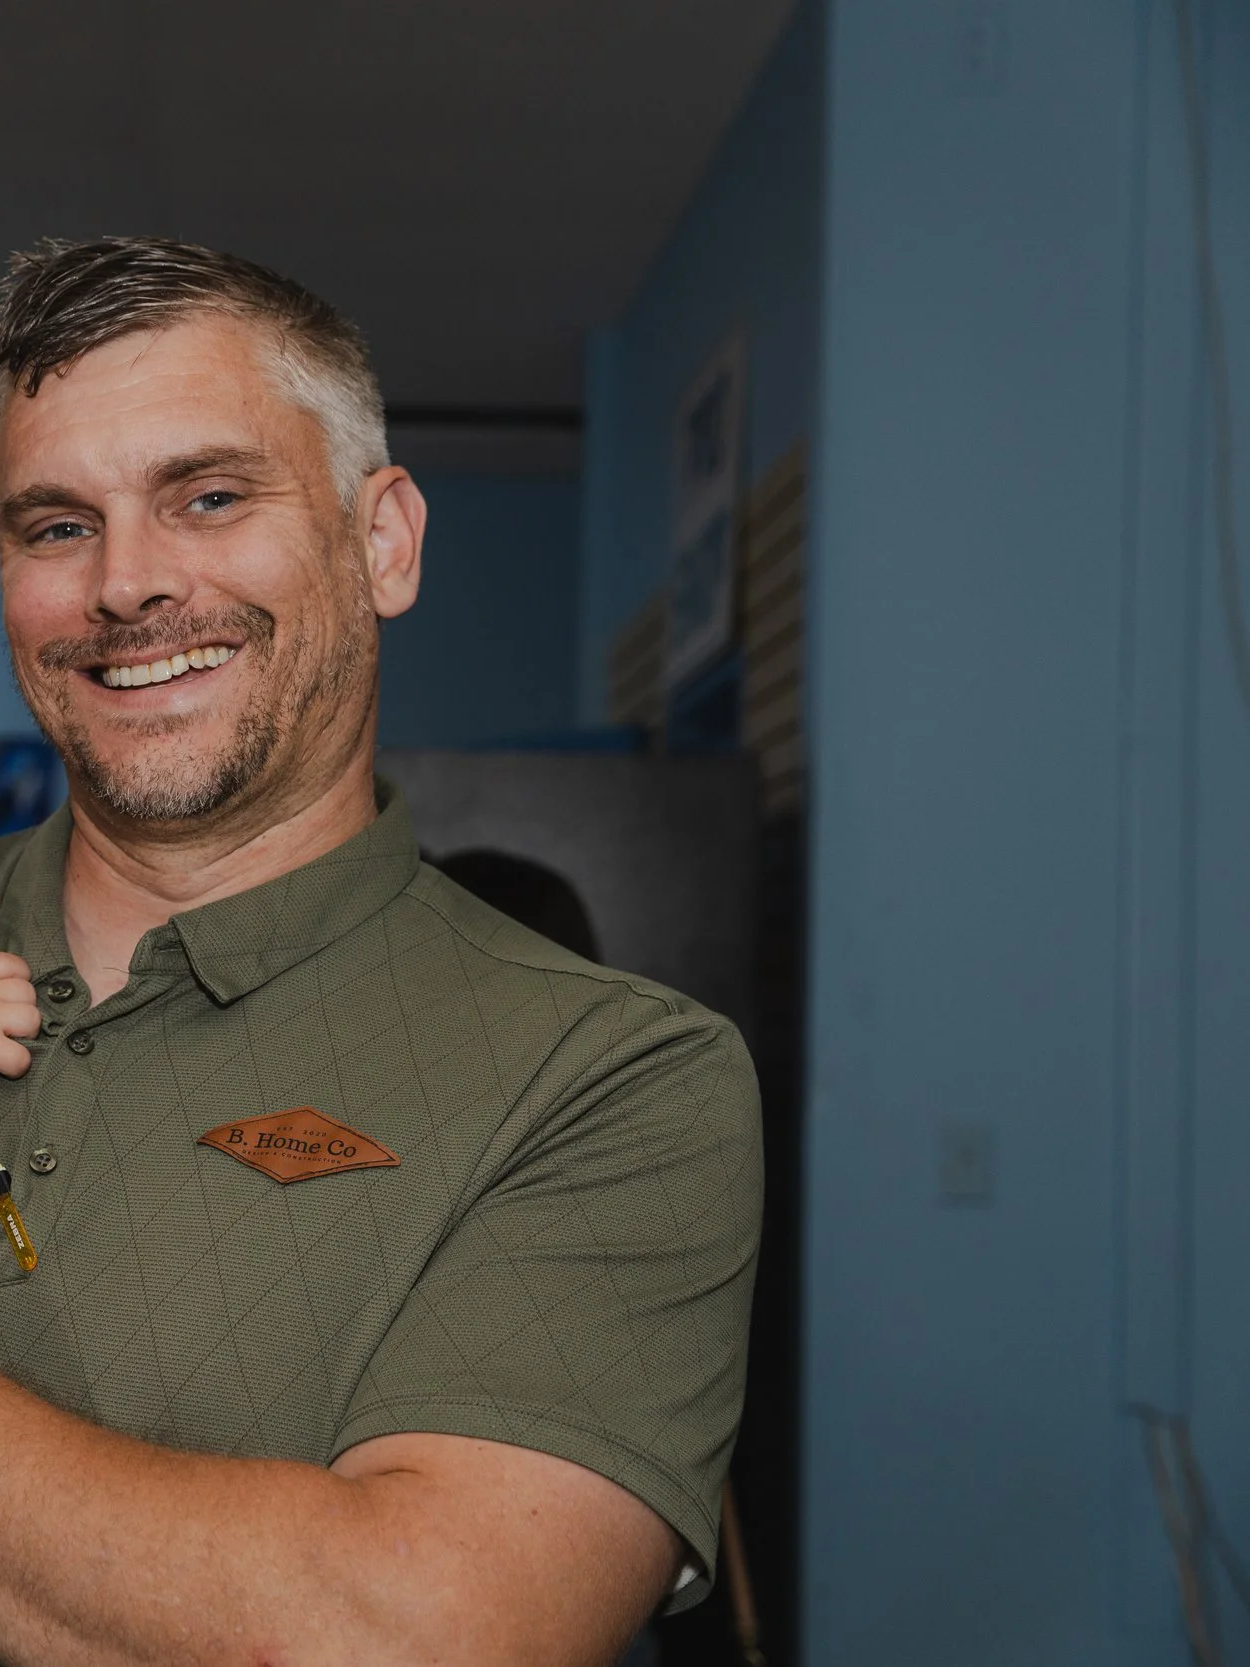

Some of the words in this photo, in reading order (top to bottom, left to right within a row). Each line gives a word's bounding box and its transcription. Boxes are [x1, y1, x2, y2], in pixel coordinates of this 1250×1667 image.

[225, 1128, 248, 1146] B.
[254, 1132, 321, 1154] Home
[327, 1140, 357, 1158] Co
[281, 1152, 342, 1165] CONSTRUCTION
[7, 1214, 25, 1250] ZEBRA
